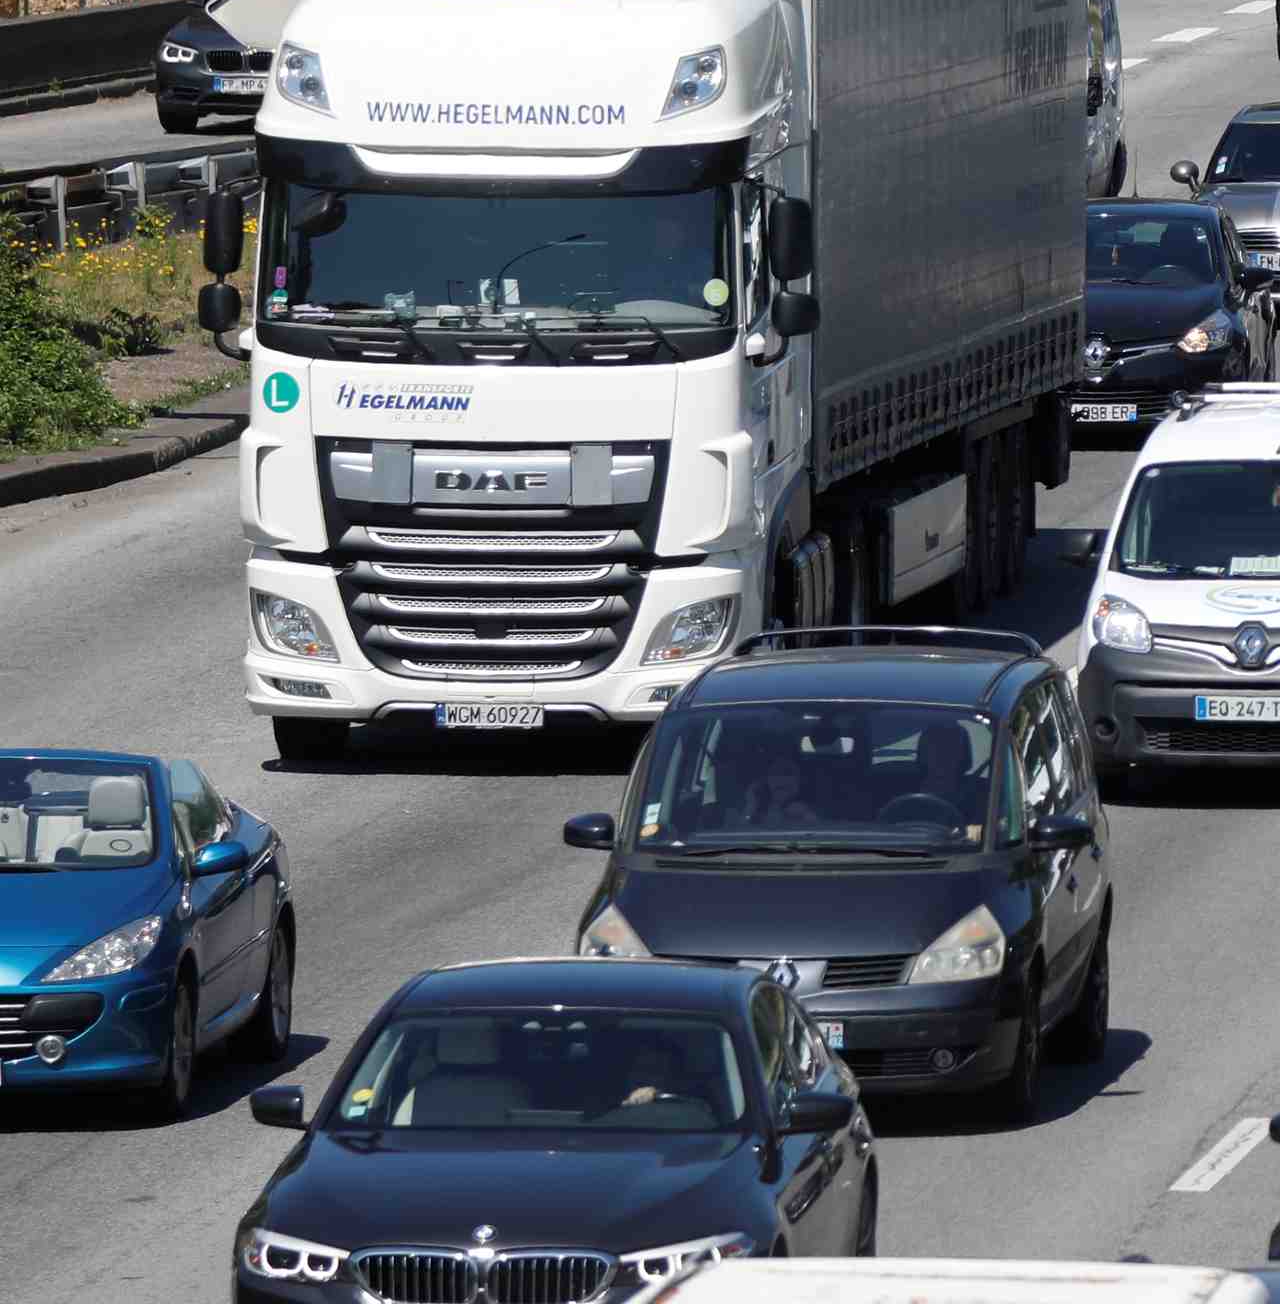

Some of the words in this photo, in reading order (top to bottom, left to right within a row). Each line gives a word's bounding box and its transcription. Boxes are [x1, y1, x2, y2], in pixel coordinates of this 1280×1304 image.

[366, 100, 626, 126] WWW.HEGELMANN.COM
[270, 378, 289, 407] L
[434, 470, 548, 492] DAF
[447, 706, 481, 724] WGM
[487, 706, 541, 725] 60927
